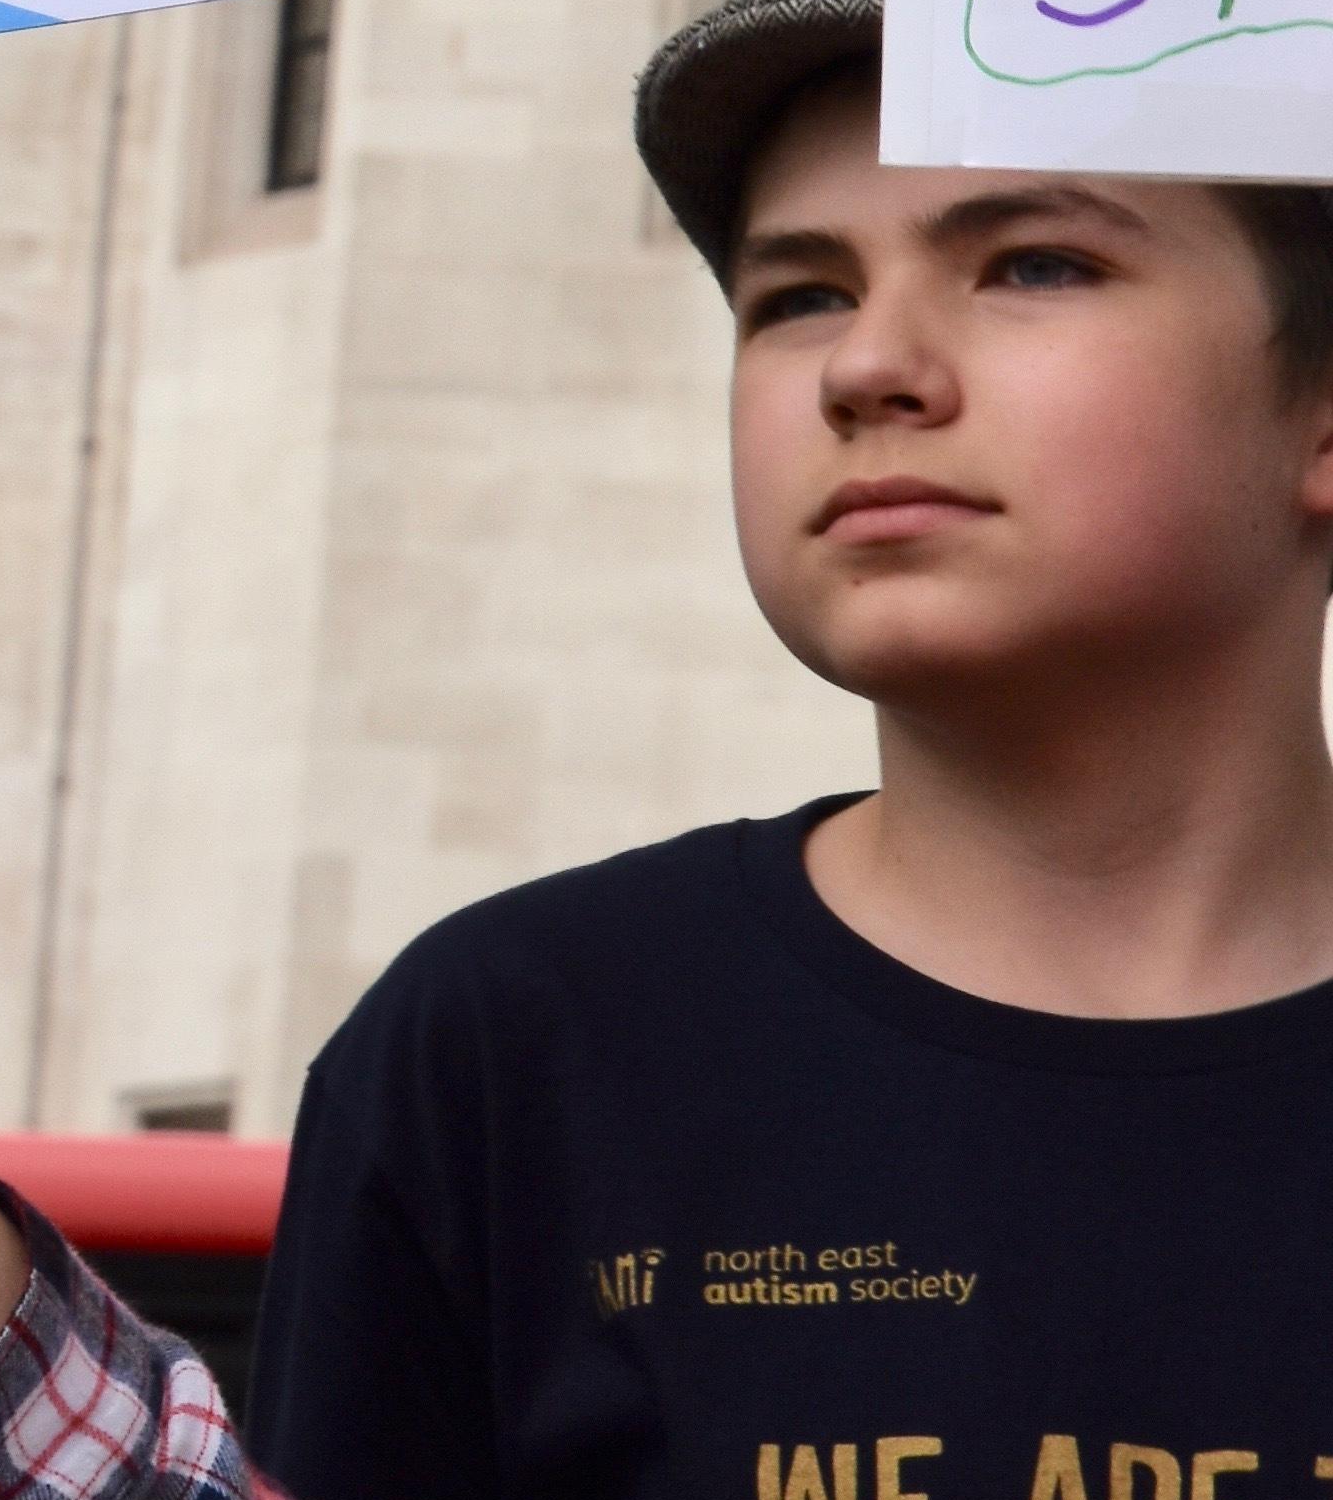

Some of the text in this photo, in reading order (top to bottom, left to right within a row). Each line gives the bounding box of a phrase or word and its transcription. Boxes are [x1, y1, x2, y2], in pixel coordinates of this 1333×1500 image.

[704, 1241, 899, 1272] north east
[703, 1275, 838, 1304] autism
[850, 1269, 977, 1305] society
